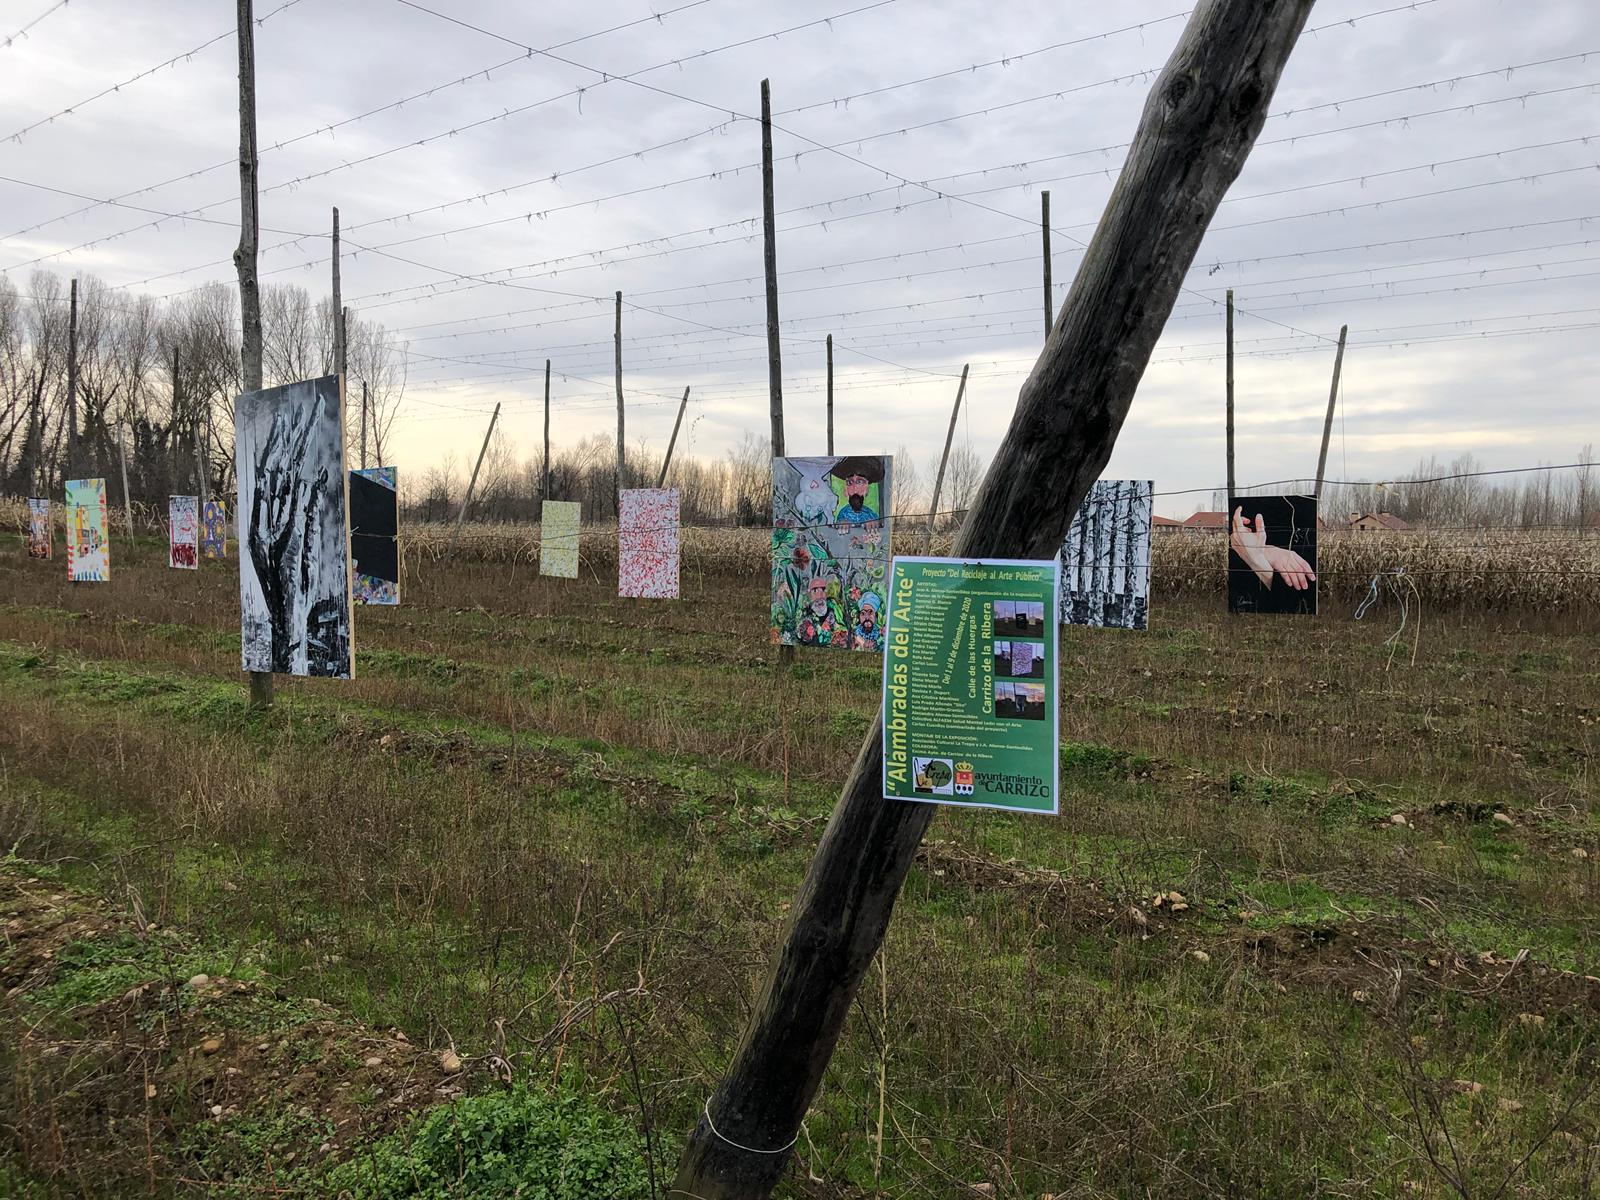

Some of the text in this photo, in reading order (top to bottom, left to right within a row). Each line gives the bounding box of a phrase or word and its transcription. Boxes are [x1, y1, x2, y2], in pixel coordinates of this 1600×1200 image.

[922, 568, 946, 578] Proyecto
[962, 569, 986, 580] Reciclaje
[990, 571, 995, 579] al
[999, 571, 1012, 580] Arte
[962, 597, 971, 612] 2020
[960, 612, 968, 621] de
[952, 622, 965, 650] diciembre
[968, 615, 977, 650] Huergas
[890, 628, 909, 658] del
[949, 650, 957, 658] de
[982, 602, 991, 713] Carrizo de la Ribera
[968, 665, 976, 676] de
[942, 674, 951, 684] Del
[975, 772, 1042, 785] ayuntamiento
[985, 781, 1049, 797] CARRIZO
